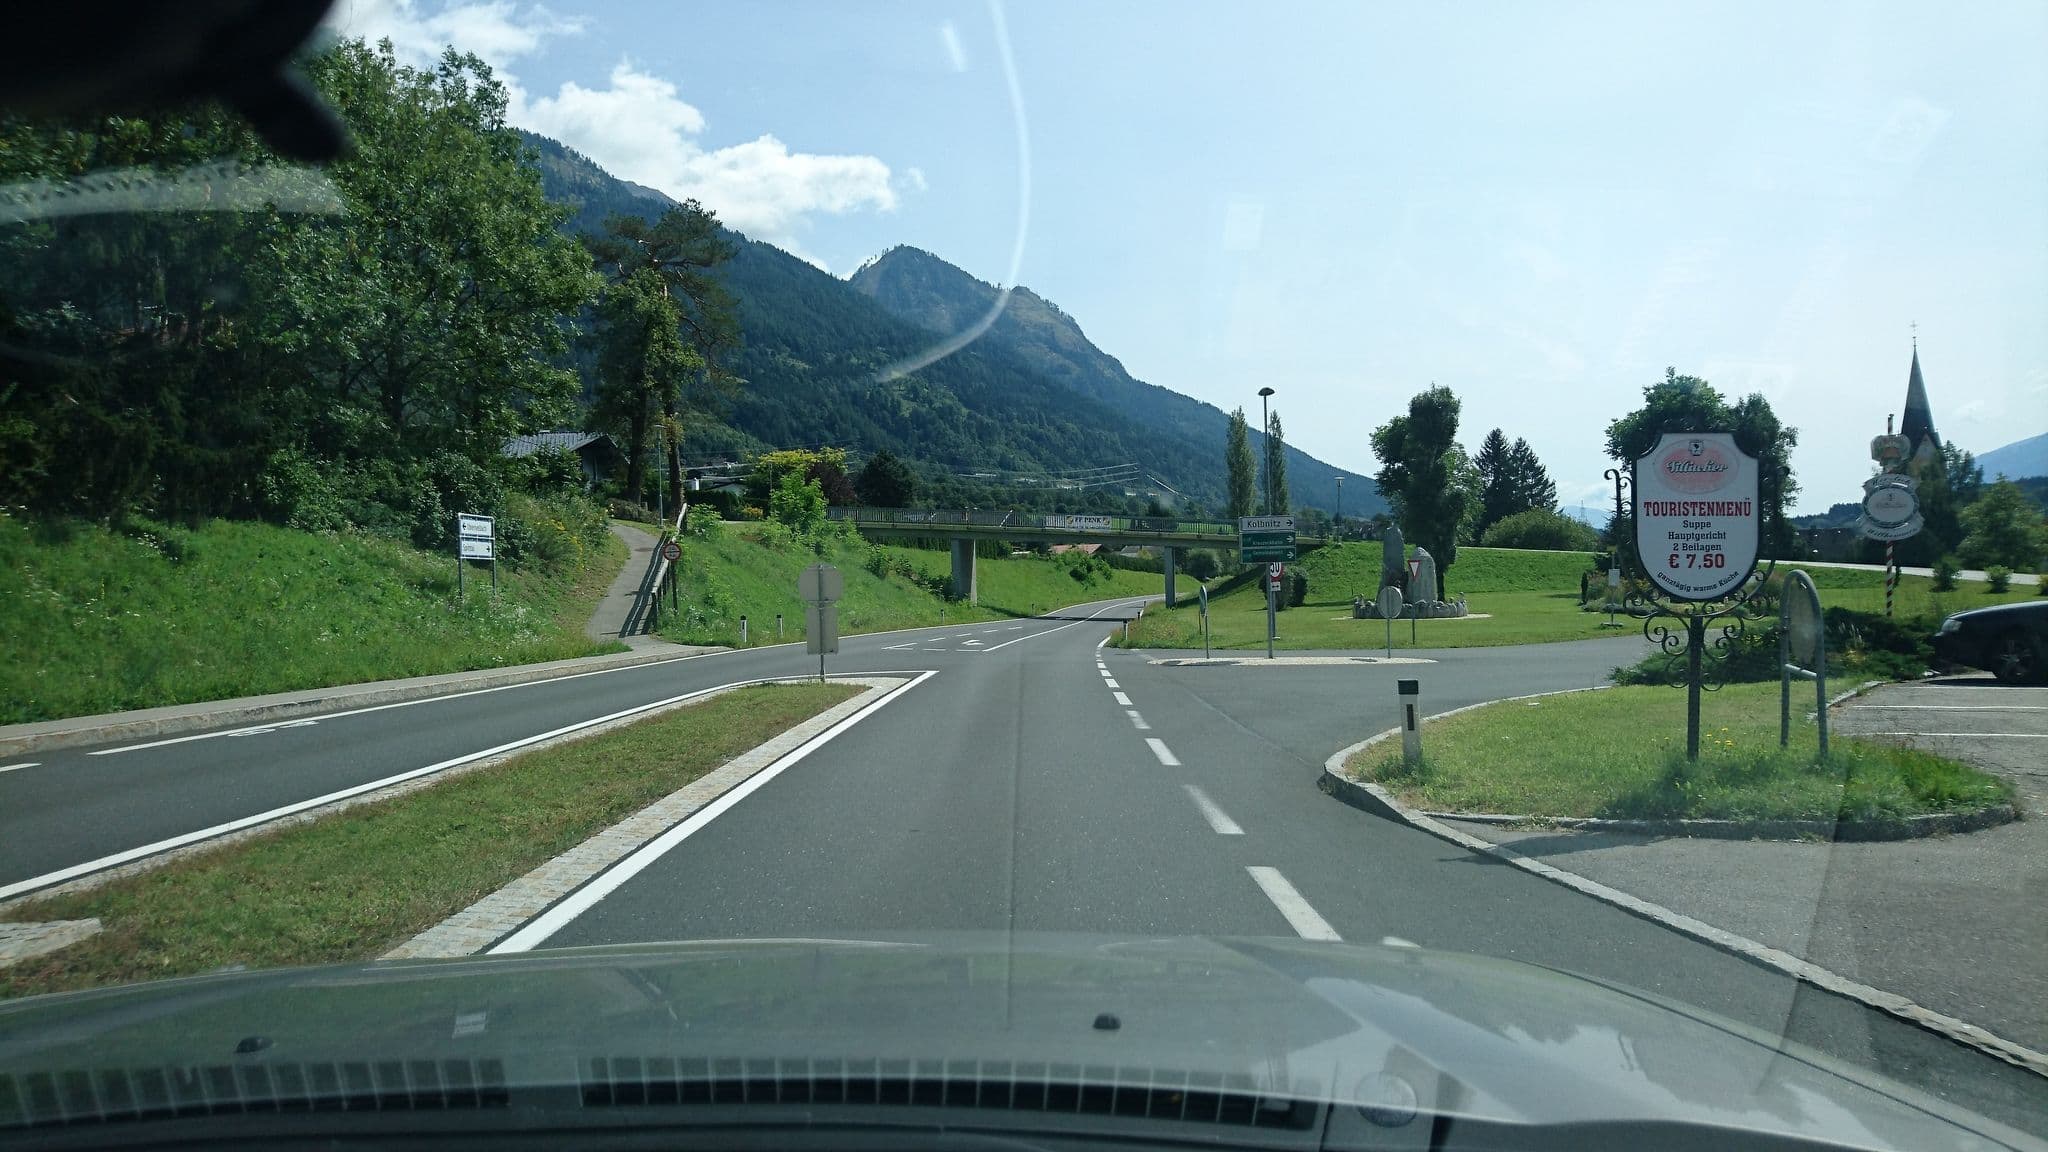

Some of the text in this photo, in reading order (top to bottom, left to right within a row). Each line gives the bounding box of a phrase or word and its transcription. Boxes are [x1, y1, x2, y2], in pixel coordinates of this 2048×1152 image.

[1643, 498, 1752, 517] TOURISTENMENÜ
[1248, 519, 1281, 528] Kolbnitz
[1682, 520, 1712, 530] Suppe
[1668, 531, 1726, 541] Hauptgericht
[1672, 543, 1722, 552] 2 Beilagen
[1669, 554, 1725, 569] € 7,50
[1657, 571, 1740, 592] ganztägig warme Küche
